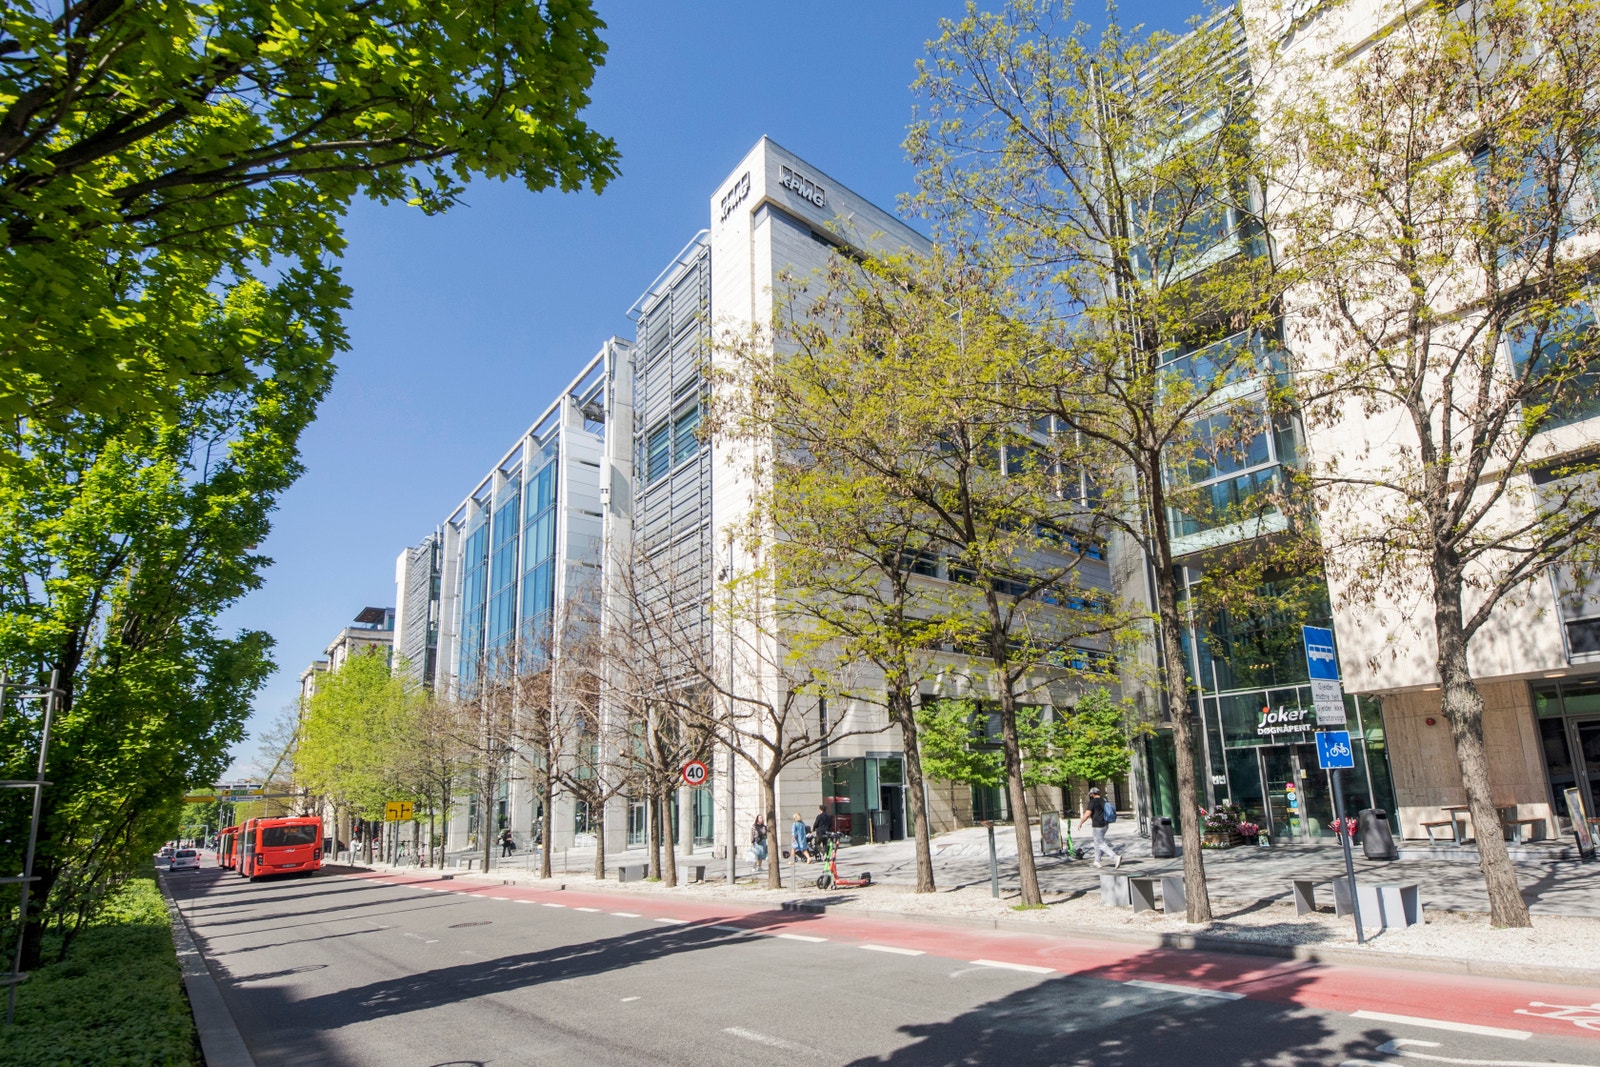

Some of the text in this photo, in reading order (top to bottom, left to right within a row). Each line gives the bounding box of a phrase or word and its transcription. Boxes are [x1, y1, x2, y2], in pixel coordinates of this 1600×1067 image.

[779, 167, 826, 208] KPMG
[1258, 705, 1308, 728] joker
[1257, 724, 1311, 735] DØGNÅPENT
[687, 766, 704, 779] 40
